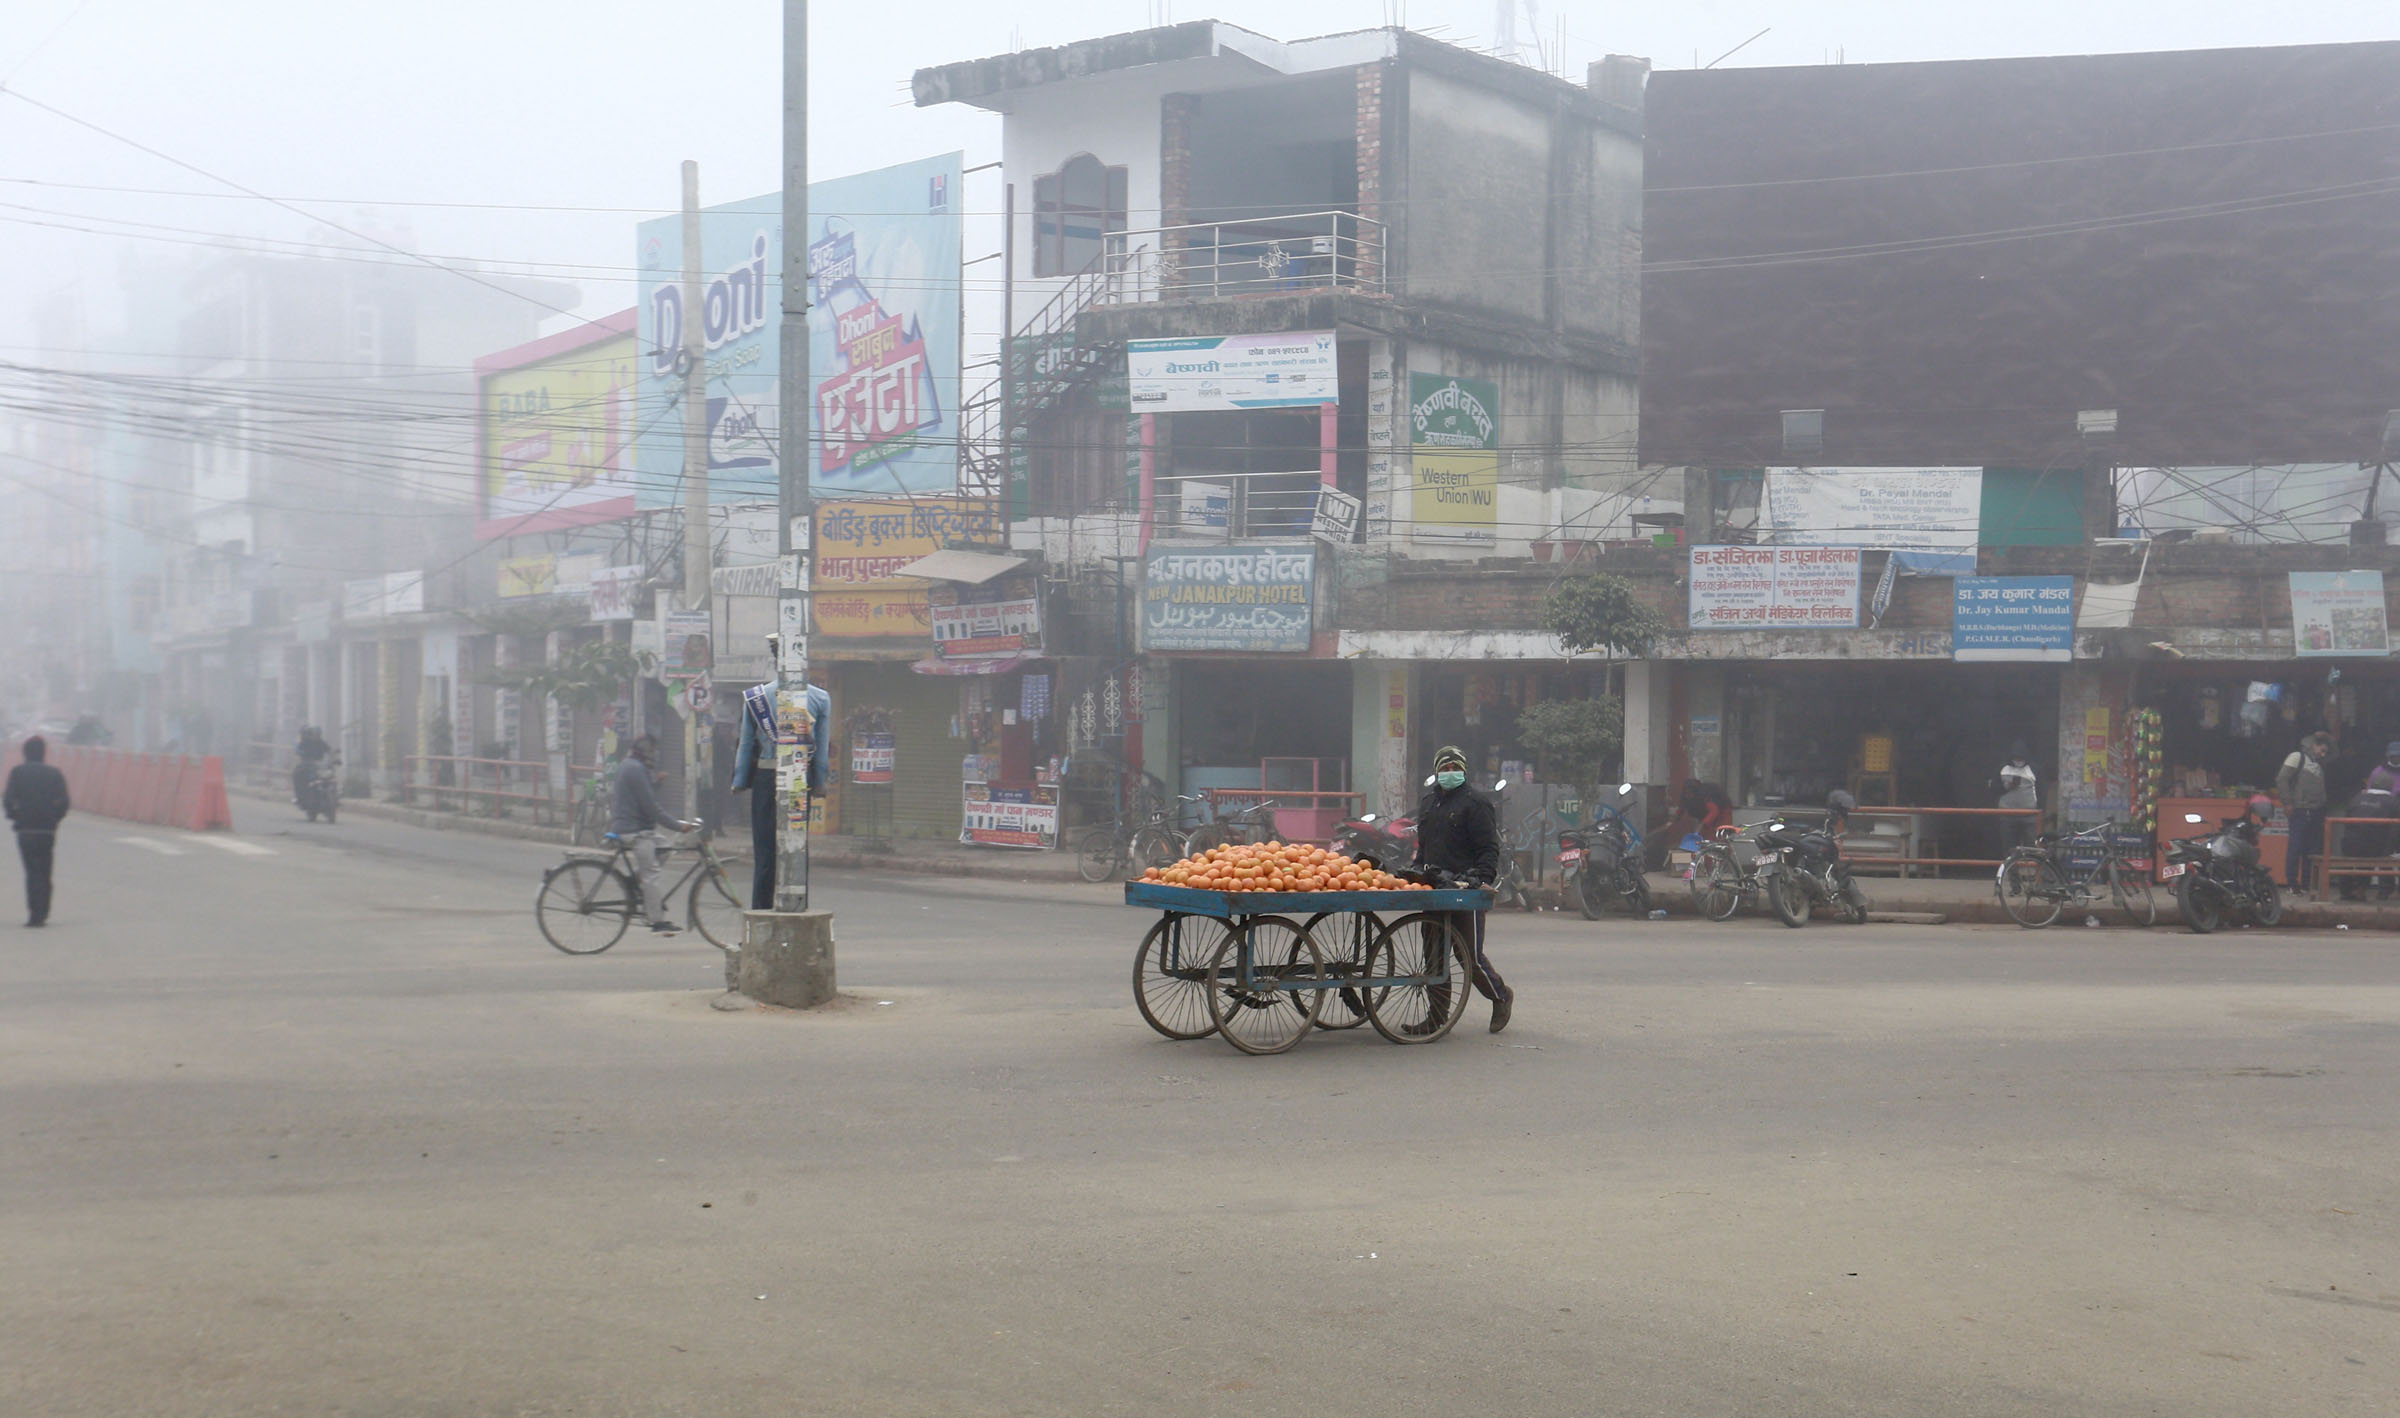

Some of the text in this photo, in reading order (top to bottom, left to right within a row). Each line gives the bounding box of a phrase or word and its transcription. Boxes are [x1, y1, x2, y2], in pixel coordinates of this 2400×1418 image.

[654, 234, 767, 374] Doni
[841, 305, 877, 347] Dhoni
[851, 324, 897, 375] साबुन
[821, 354, 921, 461] एउटा
[1421, 466, 1469, 486] Western
[1436, 486, 1492, 506] Union WU
[1859, 488, 1953, 501] Dr. Payal Mandal
[1316, 515, 1348, 537] WESTERN
[1872, 513, 1891, 521] TATA
[1324, 526, 1347, 544] UNION
[1254, 548, 1312, 583] होटल
[1694, 552, 1713, 565] डा.
[1712, 547, 1756, 565] संजित
[1779, 550, 1795, 563] डा.
[1794, 550, 1818, 566] पूजा
[1149, 583, 1308, 604] NEW JANAKPUR HOTEL
[1958, 588, 1975, 601] डा.
[1977, 588, 2001, 601] जय
[2002, 588, 2037, 604] कुमार
[1958, 605, 2071, 618] Dr. Jay Kumar Mandal
